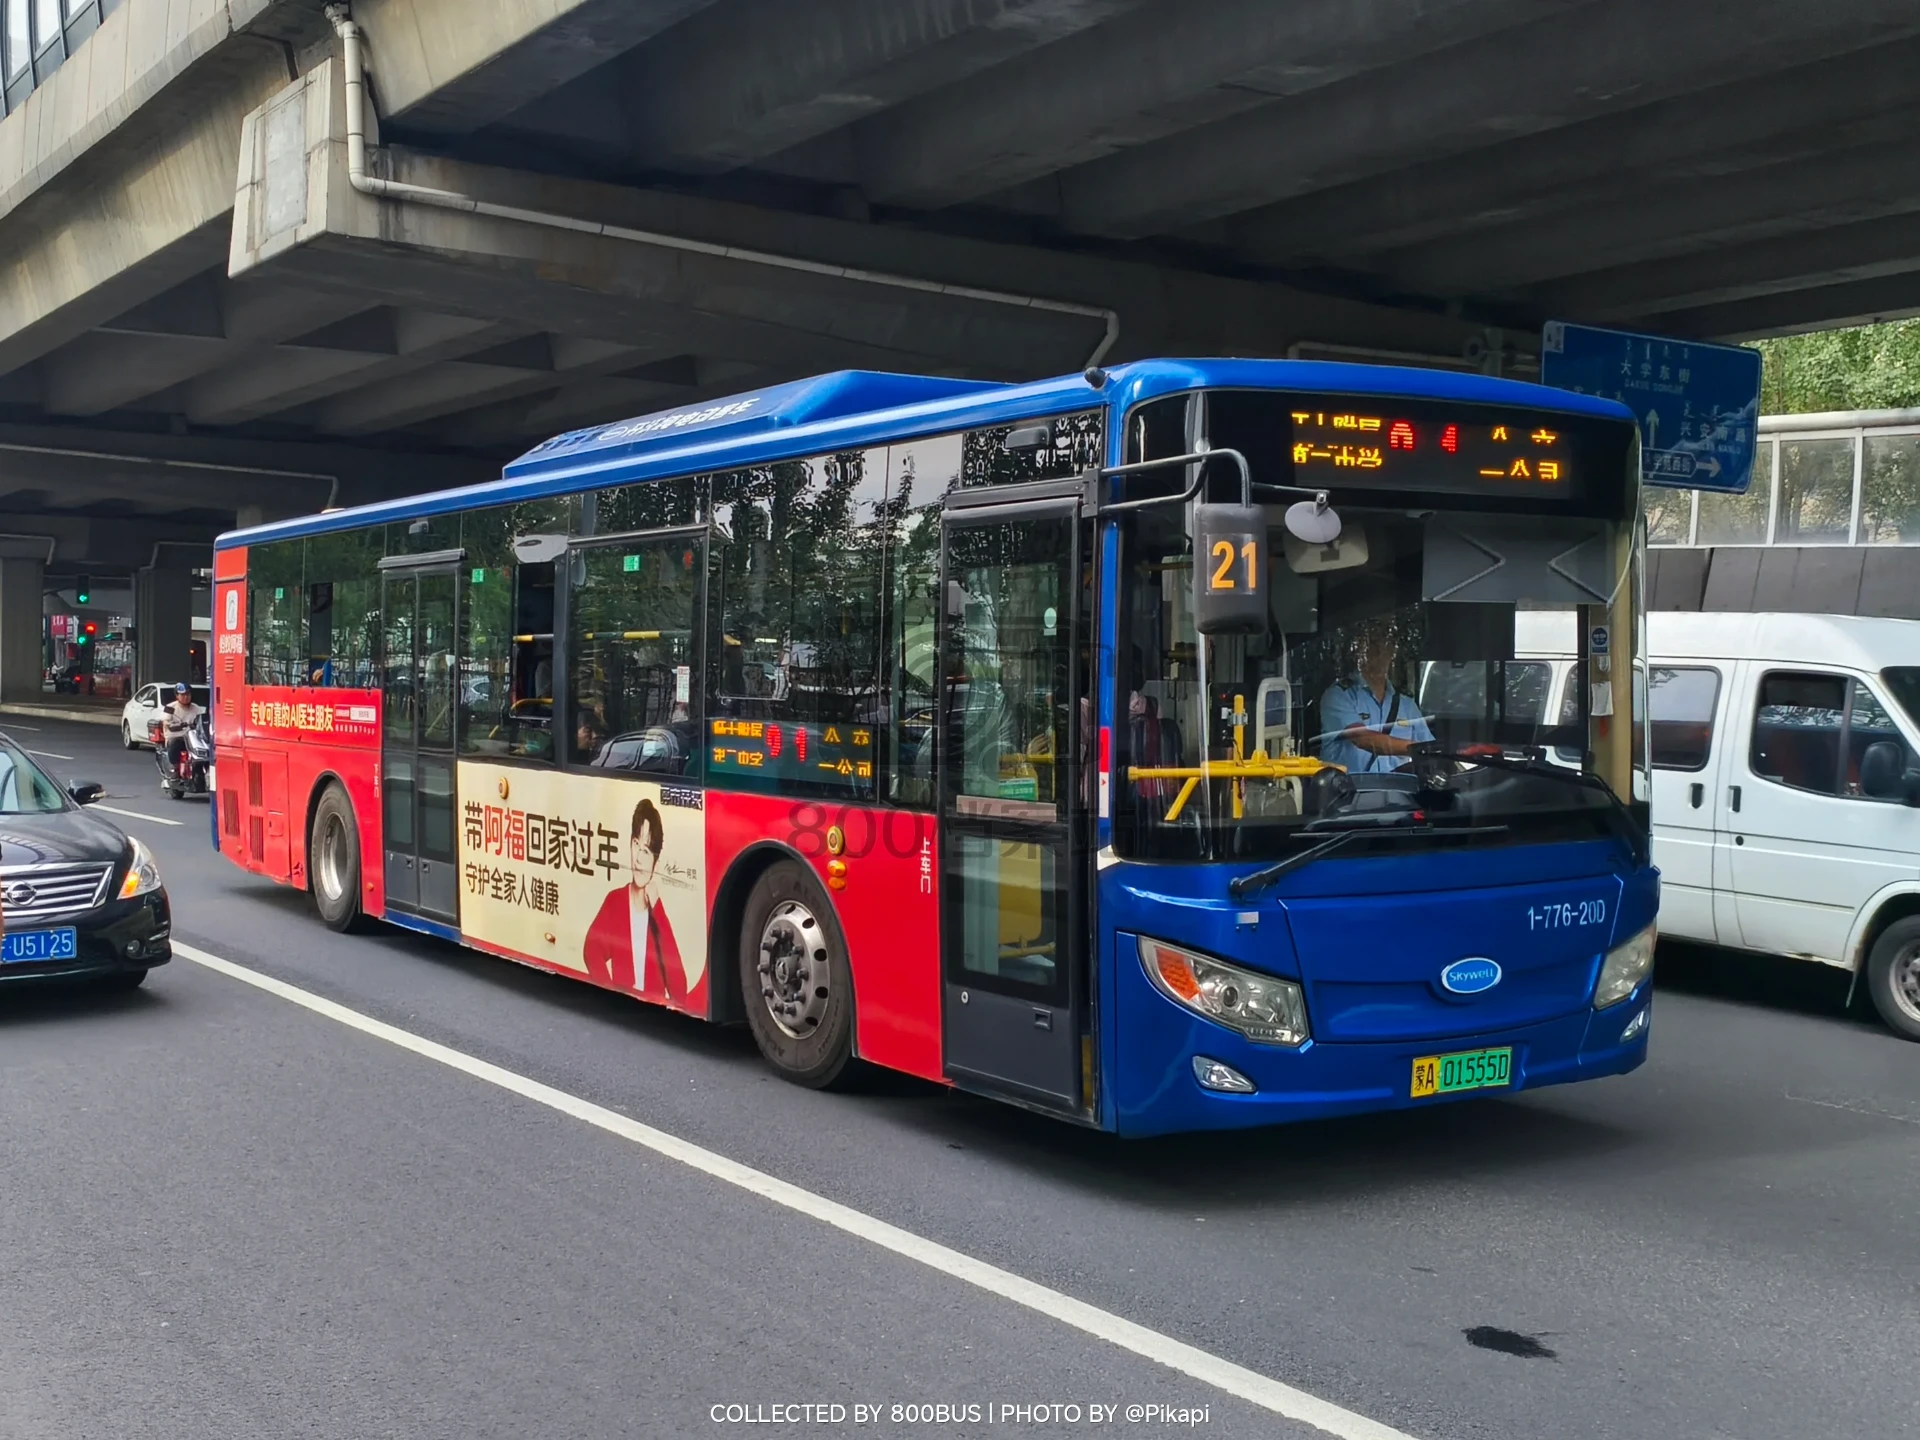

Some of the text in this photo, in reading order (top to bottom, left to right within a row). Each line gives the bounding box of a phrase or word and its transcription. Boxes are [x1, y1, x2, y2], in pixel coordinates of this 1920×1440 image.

[1211, 540, 1256, 589] 21
[250, 700, 334, 732] 专业可靠的AI医生朋友
[464, 800, 620, 882] 带阿福回家过年
[919, 836, 932, 894] 上车门
[465, 862, 560, 917] 守护全家人健康
